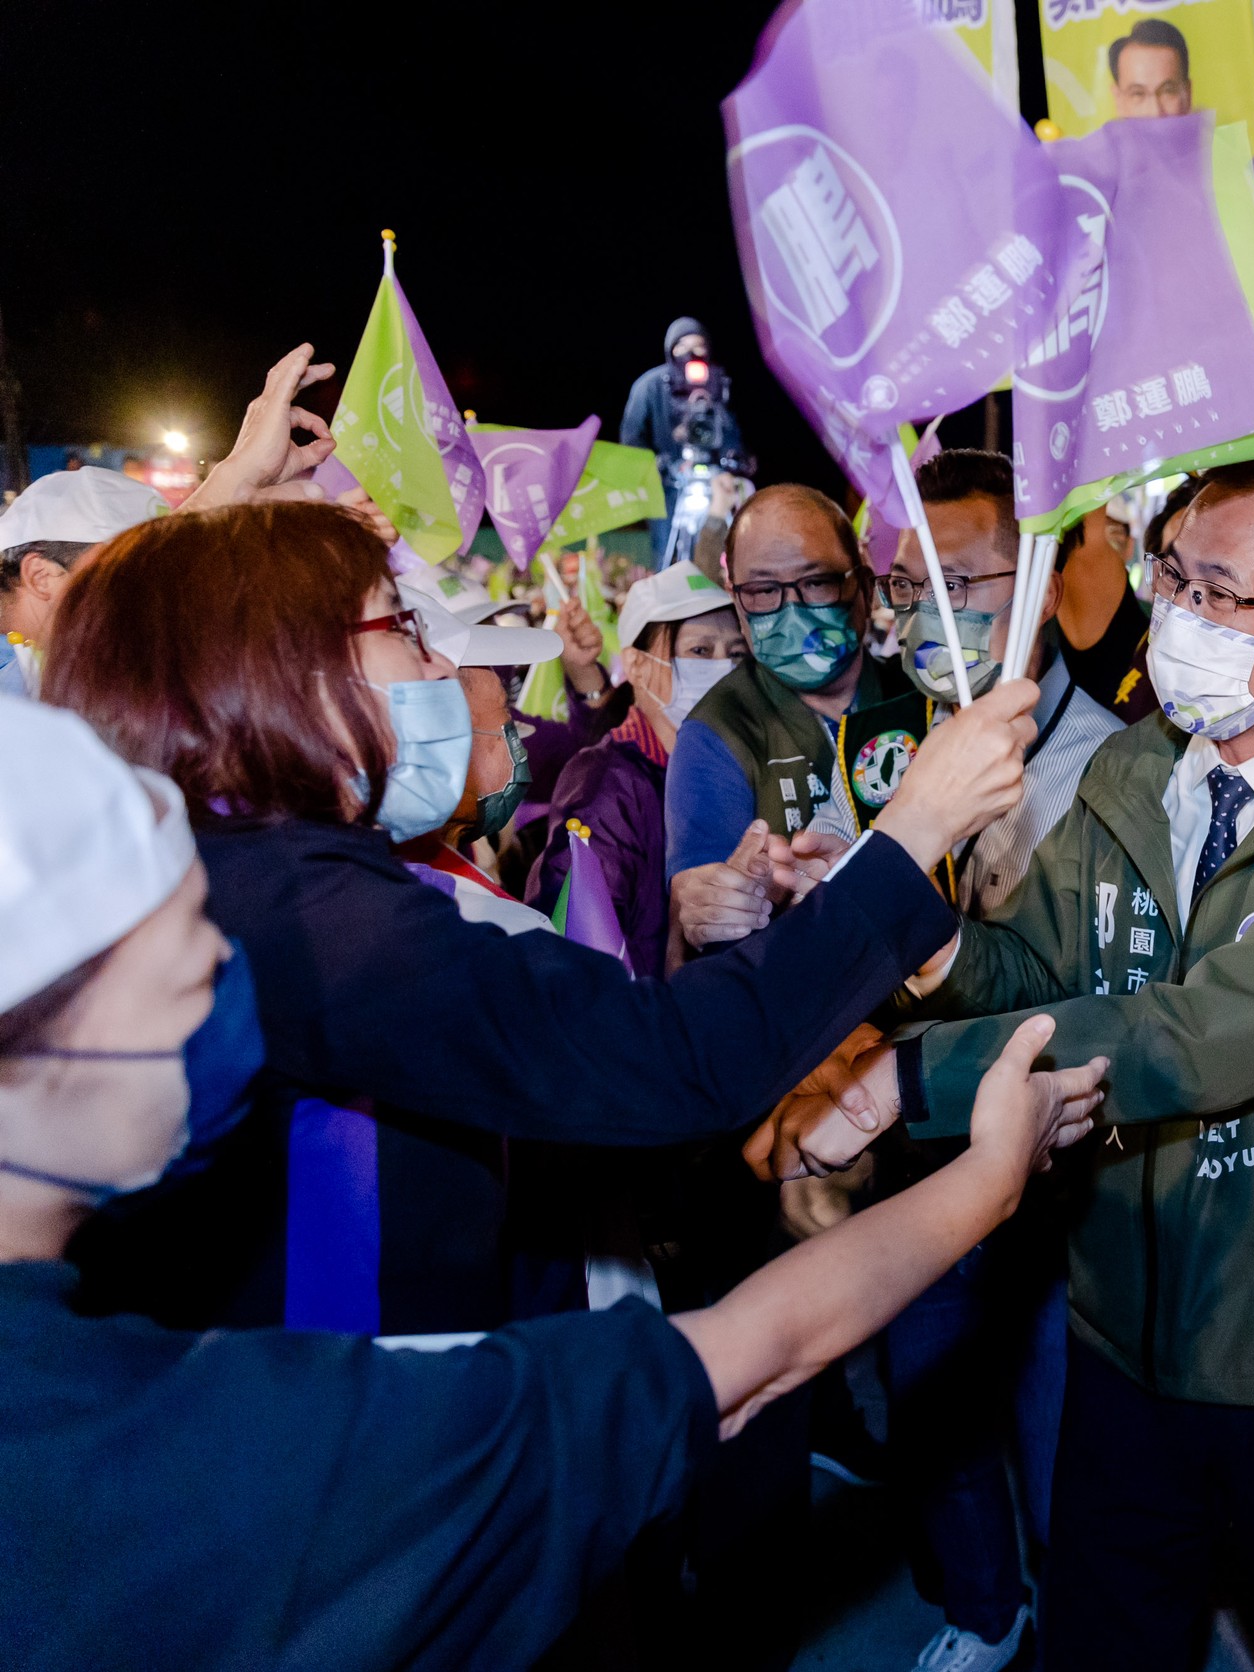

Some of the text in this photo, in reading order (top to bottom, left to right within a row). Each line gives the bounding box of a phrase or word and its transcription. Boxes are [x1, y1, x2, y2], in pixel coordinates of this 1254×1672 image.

[931, 233, 1044, 349] 鄭運鵬
[1093, 364, 1213, 432] 鄭運鵬
[1103, 408, 1220, 457] TAOYUAN
[1104, 1124, 1125, 1151] 人
